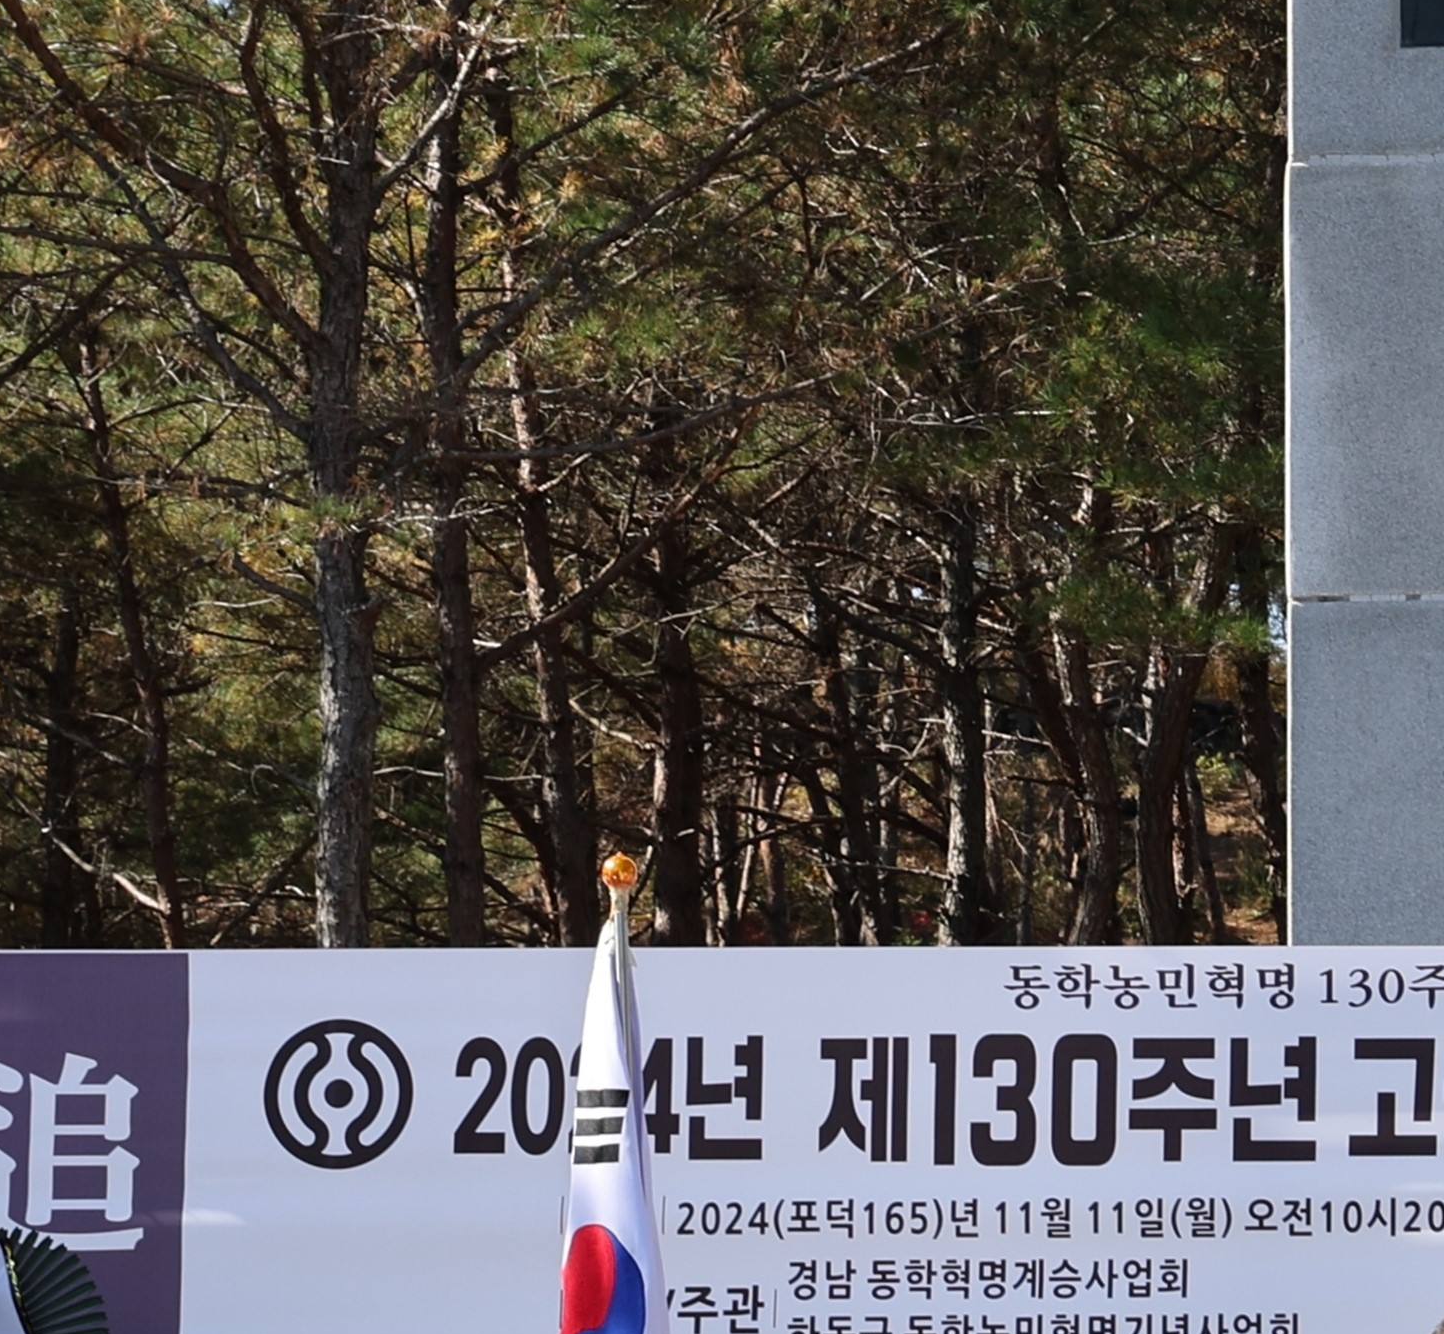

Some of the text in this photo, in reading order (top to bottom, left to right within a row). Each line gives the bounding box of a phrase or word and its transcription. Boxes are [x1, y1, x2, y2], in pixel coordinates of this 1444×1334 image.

[1004, 963, 1297, 1011] 동학농민혁명
[453, 1035, 763, 1160] 204년
[818, 1033, 1318, 1167] 제130주년
[677, 1196, 979, 1241] 2024(포덕165)년
[996, 1198, 1073, 1239] 11월
[1088, 1198, 1234, 1241] 11일(월)
[788, 1258, 1190, 1301] 경남 동학혁명계승사업회
